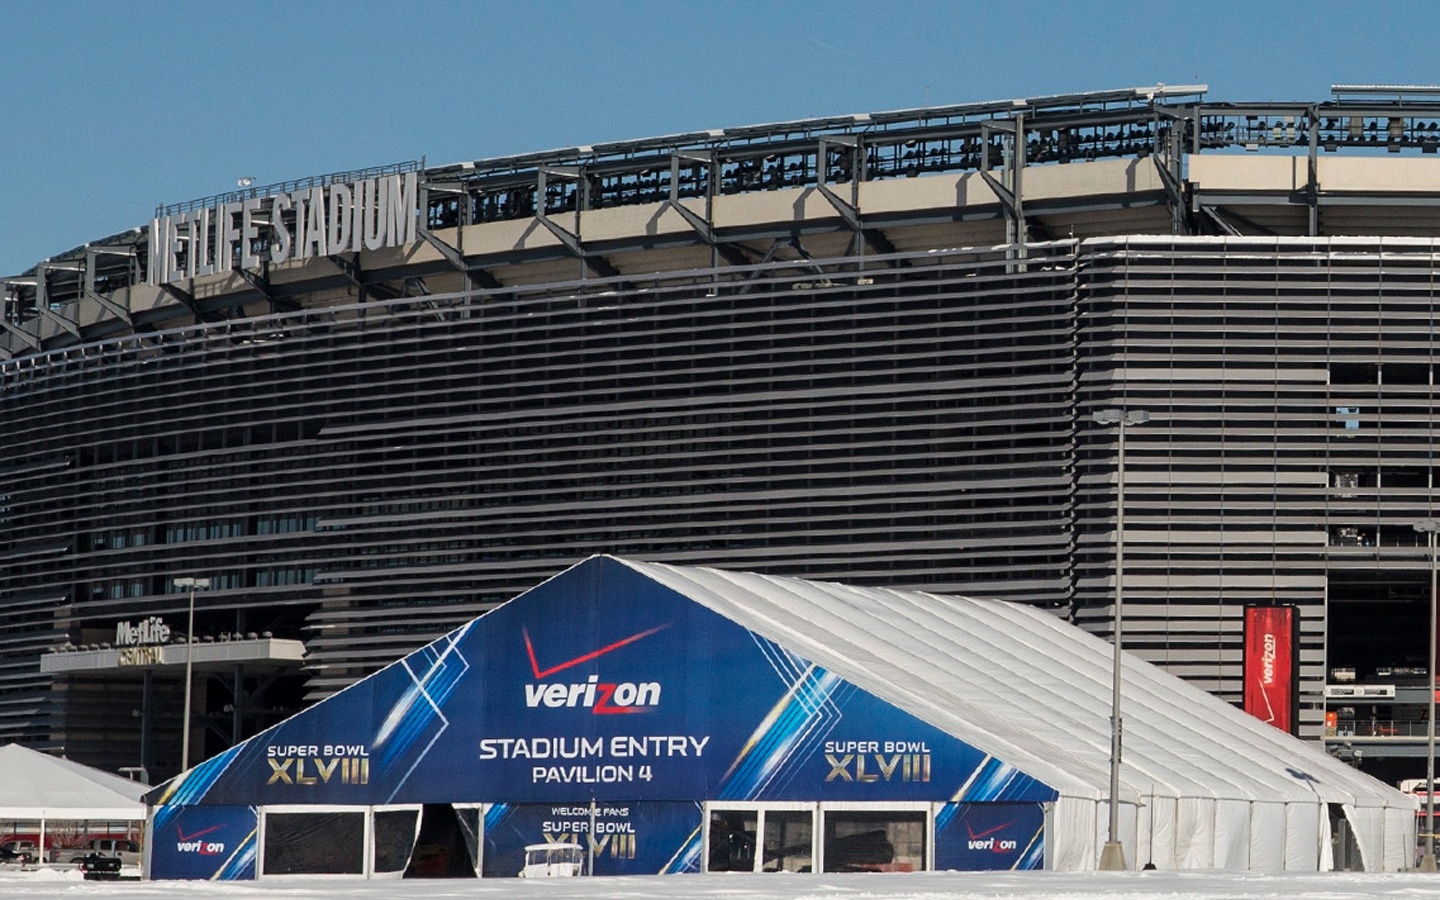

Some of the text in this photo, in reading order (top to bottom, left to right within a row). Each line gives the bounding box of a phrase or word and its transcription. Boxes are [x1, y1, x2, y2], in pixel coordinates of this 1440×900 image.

[146, 172, 418, 287] METLIFE STADIUM
[116, 616, 170, 645] MetLife
[1262, 633, 1276, 684] verizon
[525, 675, 661, 715] verizon
[267, 745, 370, 757] SUPER BOWL
[479, 736, 710, 760] STADIUM ENTRY
[824, 741, 931, 753] SUPER BOWL
[266, 758, 370, 785] XLVIII
[532, 766, 653, 783] PAVILION 4
[824, 754, 931, 782] XLVIII
[552, 807, 629, 816] WELCOME FANS
[543, 821, 636, 833] SUPER BOWL
[177, 840, 225, 855] verizon
[968, 837, 1016, 853] verizon
